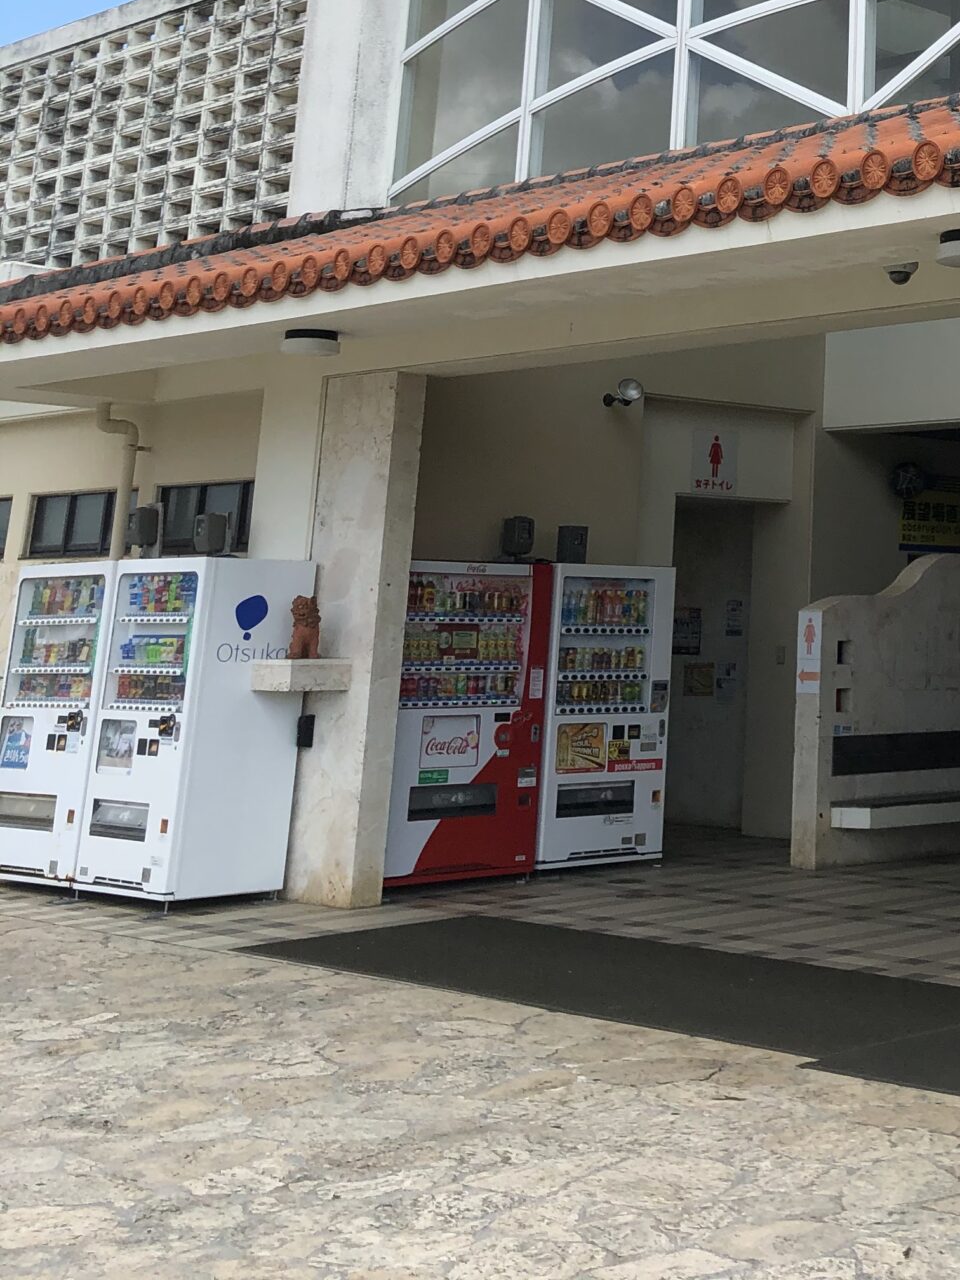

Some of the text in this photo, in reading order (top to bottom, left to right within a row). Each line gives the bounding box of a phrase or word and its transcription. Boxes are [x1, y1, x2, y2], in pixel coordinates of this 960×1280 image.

[696, 479, 733, 490] 女子トイレ
[217, 642, 288, 663] Otsuka
